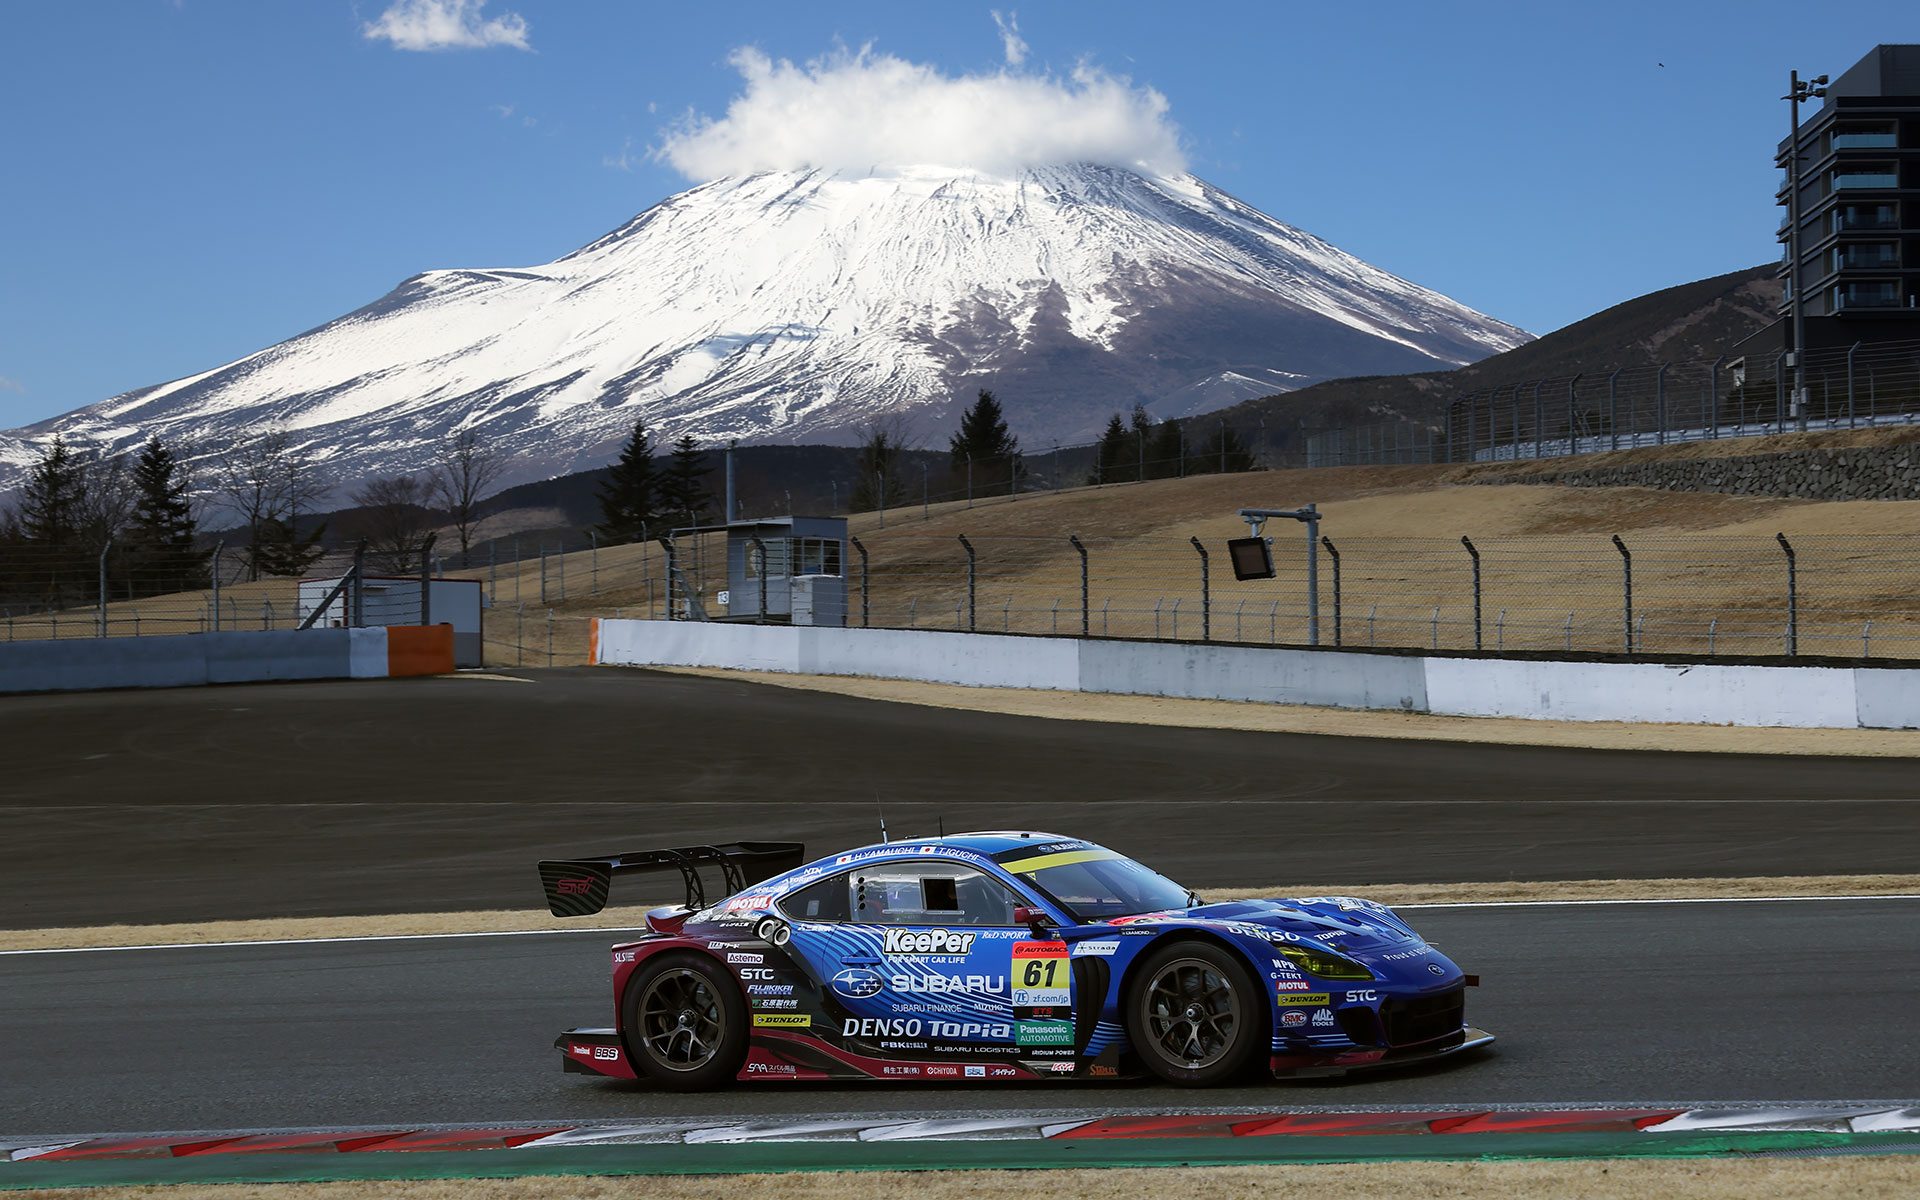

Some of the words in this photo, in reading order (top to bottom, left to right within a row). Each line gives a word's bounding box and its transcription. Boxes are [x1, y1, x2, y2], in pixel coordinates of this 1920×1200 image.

[719, 592, 729, 603] 13
[728, 896, 772, 911] MOTUL
[981, 931, 1001, 940] R&D
[1000, 931, 1030, 940] SPORT
[1226, 925, 1301, 942] DENSO
[883, 927, 977, 956] KeePer
[728, 954, 763, 963] Astemo
[888, 956, 904, 964] FOR
[905, 956, 930, 964] SMART
[931, 956, 947, 964] CAR
[948, 956, 966, 965] LIFE
[1271, 958, 1297, 971] NPR
[740, 968, 775, 980] STC
[1023, 959, 1058, 988] 61
[1270, 972, 1302, 980] G-TEKT
[747, 984, 794, 994] FUJIKIKAI
[891, 974, 1004, 994] SUBARU
[1278, 981, 1308, 990] MOTUL
[1033, 994, 1069, 1004] zf.com/jp
[1345, 990, 1377, 1002] STC
[891, 1004, 926, 1013] SUBARU
[927, 1004, 963, 1013] FINANCE
[1284, 1014, 1305, 1023] BMC
[1312, 1008, 1335, 1022] MAC
[842, 1018, 923, 1038] DENSO
[1019, 1024, 1068, 1035] Panasonic
[1019, 1034, 1071, 1043] AUTOMOTIVE
[594, 1047, 618, 1060] BBS
[933, 1045, 972, 1053] SUBARU
[933, 1067, 959, 1076] CHIYODA
